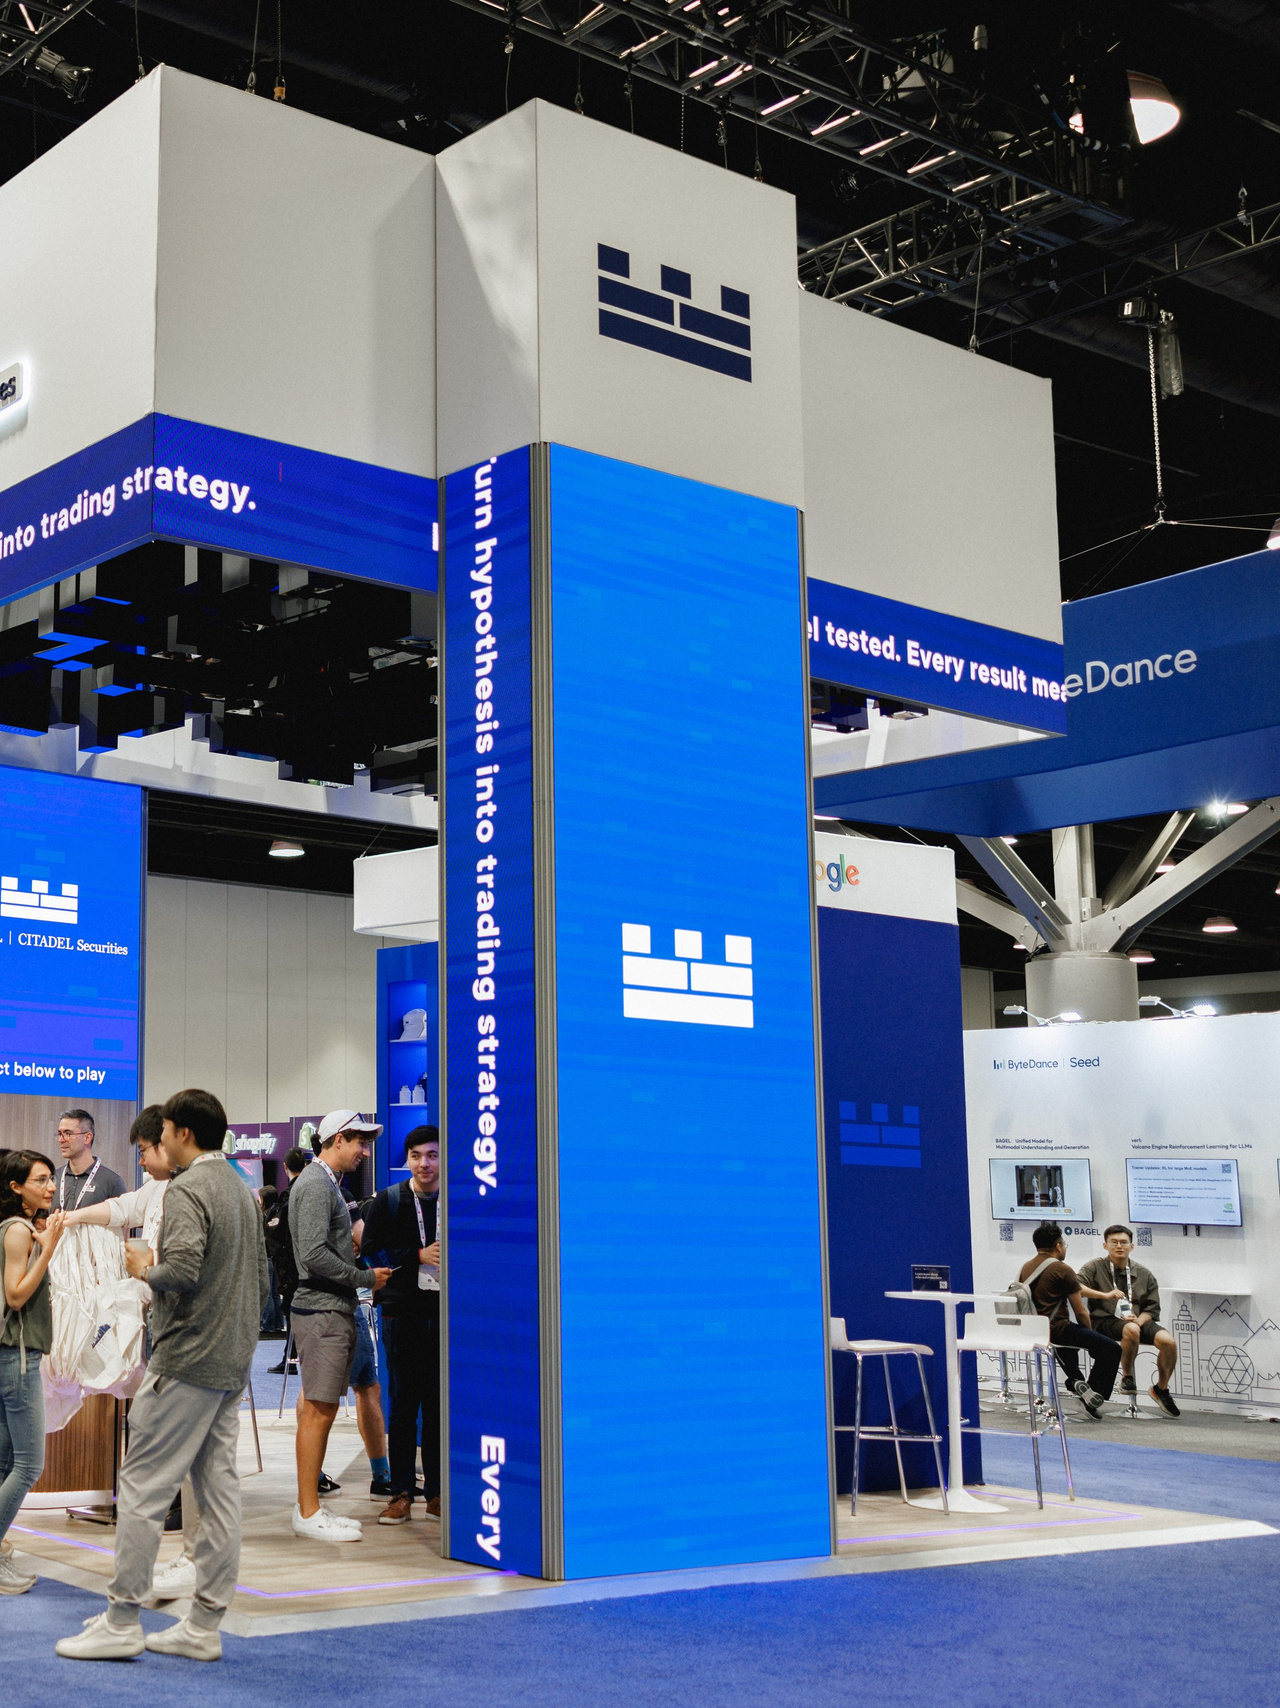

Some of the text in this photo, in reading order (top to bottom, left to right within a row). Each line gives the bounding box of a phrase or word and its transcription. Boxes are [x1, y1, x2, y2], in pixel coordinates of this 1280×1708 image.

[40, 484, 116, 539] trading
[122, 465, 257, 514] strategy.
[825, 621, 902, 663] tested.
[906, 639, 965, 683] Every
[969, 661, 1028, 694] result
[469, 456, 502, 1198] urn hypothesis into trading strategy.
[17, 932, 74, 950] CITADEL
[76, 939, 129, 956] Securities
[13, 1061, 56, 1079] below
[58, 1065, 74, 1080] to
[77, 1066, 106, 1085] play
[1007, 1055, 1101, 1072] ByteDance Seed
[1074, 1228, 1101, 1236] BAGEL
[476, 1435, 506, 1561] Every
